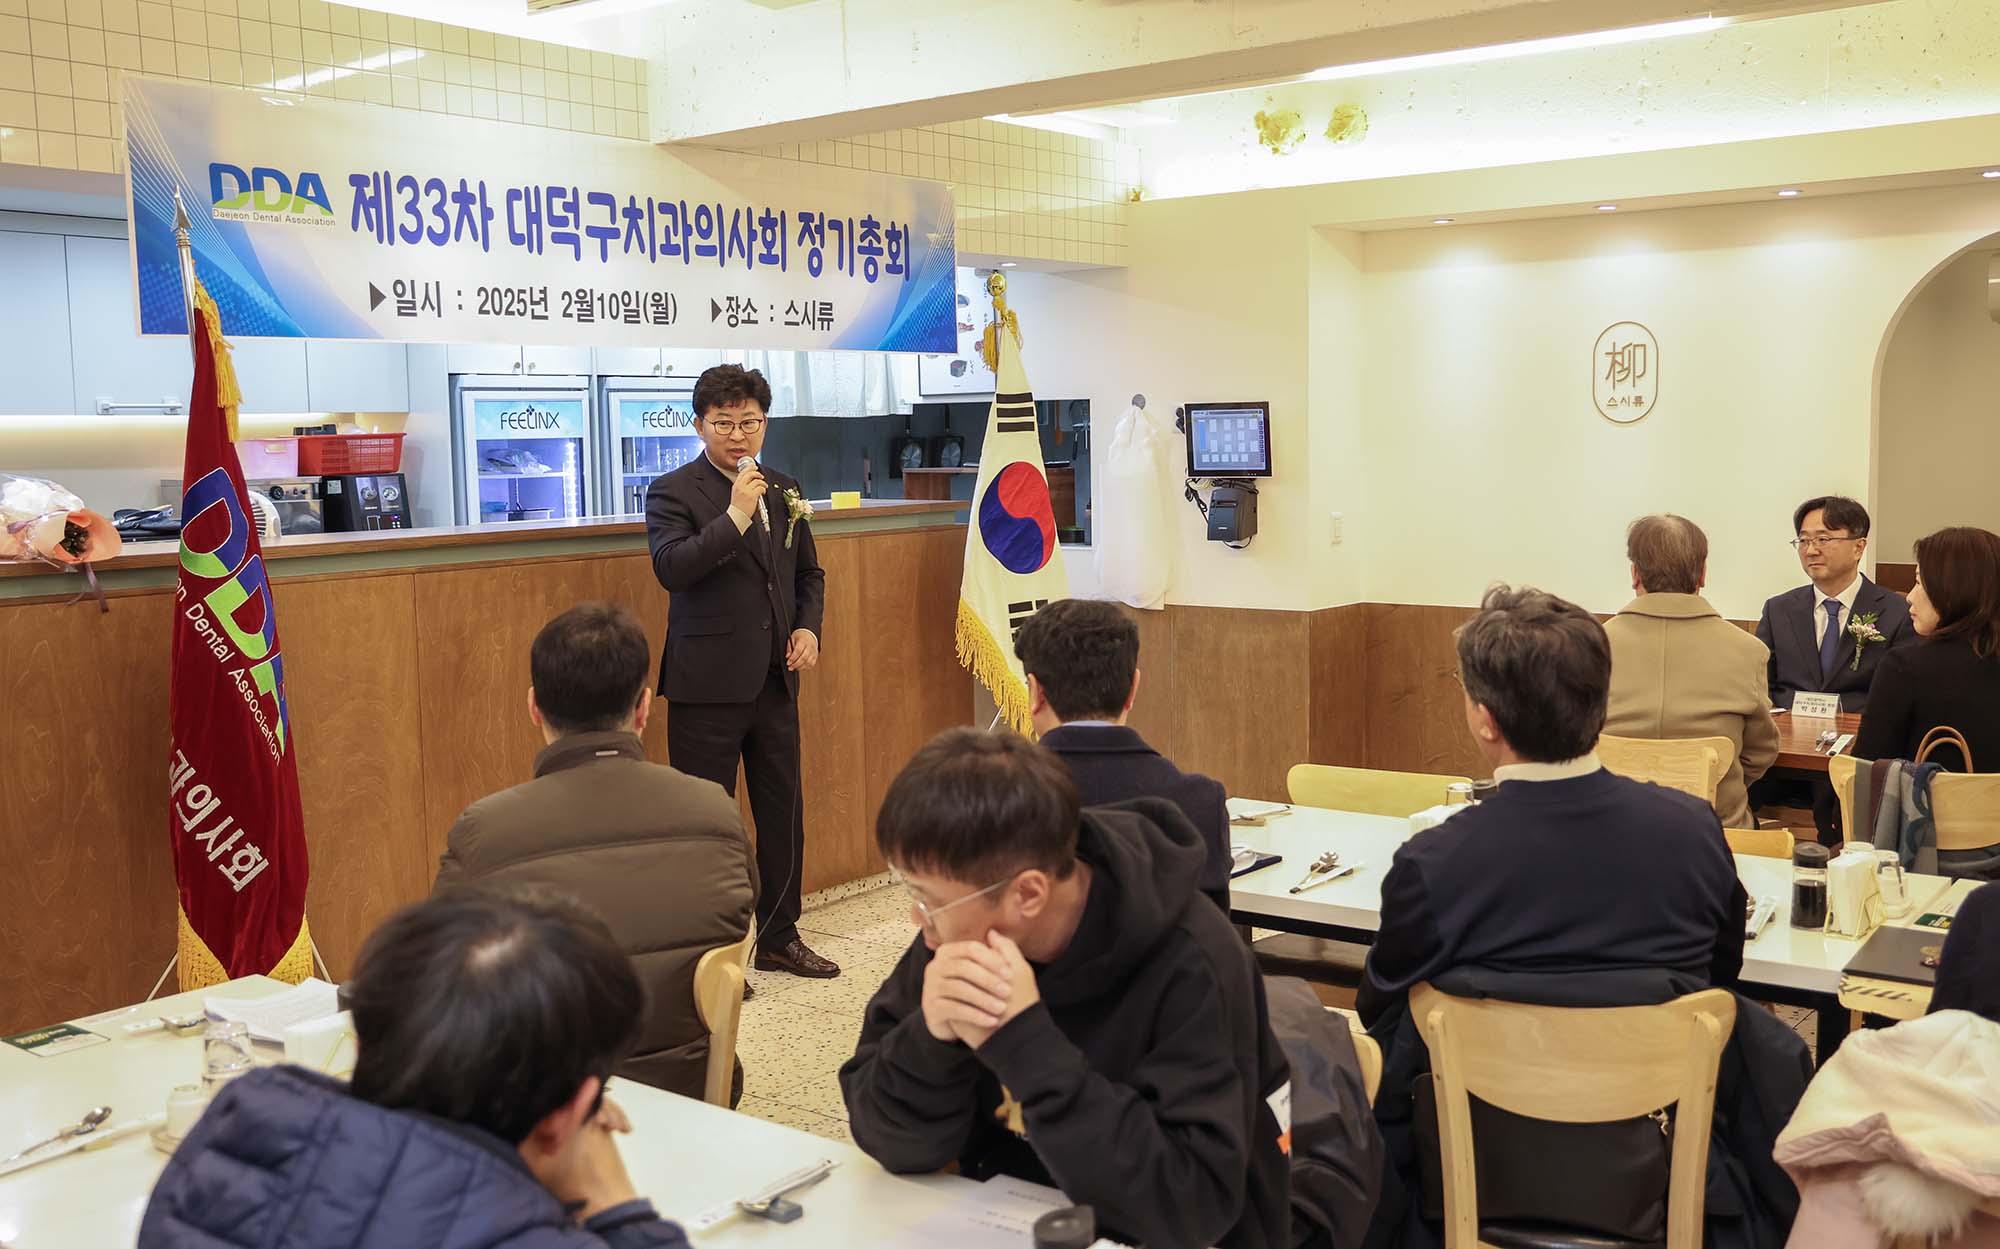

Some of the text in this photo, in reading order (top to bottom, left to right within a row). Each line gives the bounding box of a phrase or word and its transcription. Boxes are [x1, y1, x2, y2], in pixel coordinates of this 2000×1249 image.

[208, 162, 334, 217] DDA
[213, 208, 337, 227] Daejeon Dental Association
[348, 170, 910, 284] 제33차 대덕구치과의사회 정기총회
[392, 279, 442, 318] 일시
[476, 286, 549, 321] 2025년
[561, 288, 678, 326] 2월10일(월)
[726, 295, 759, 328] 장소
[784, 300, 835, 332] 스시류
[1604, 341, 1647, 391] 柳
[500, 410, 560, 430] FEELINX
[1606, 395, 1645, 408] 스시류
[185, 602, 236, 664] Dental
[228, 667, 281, 767] Association
[168, 738, 270, 893] 과의사회
